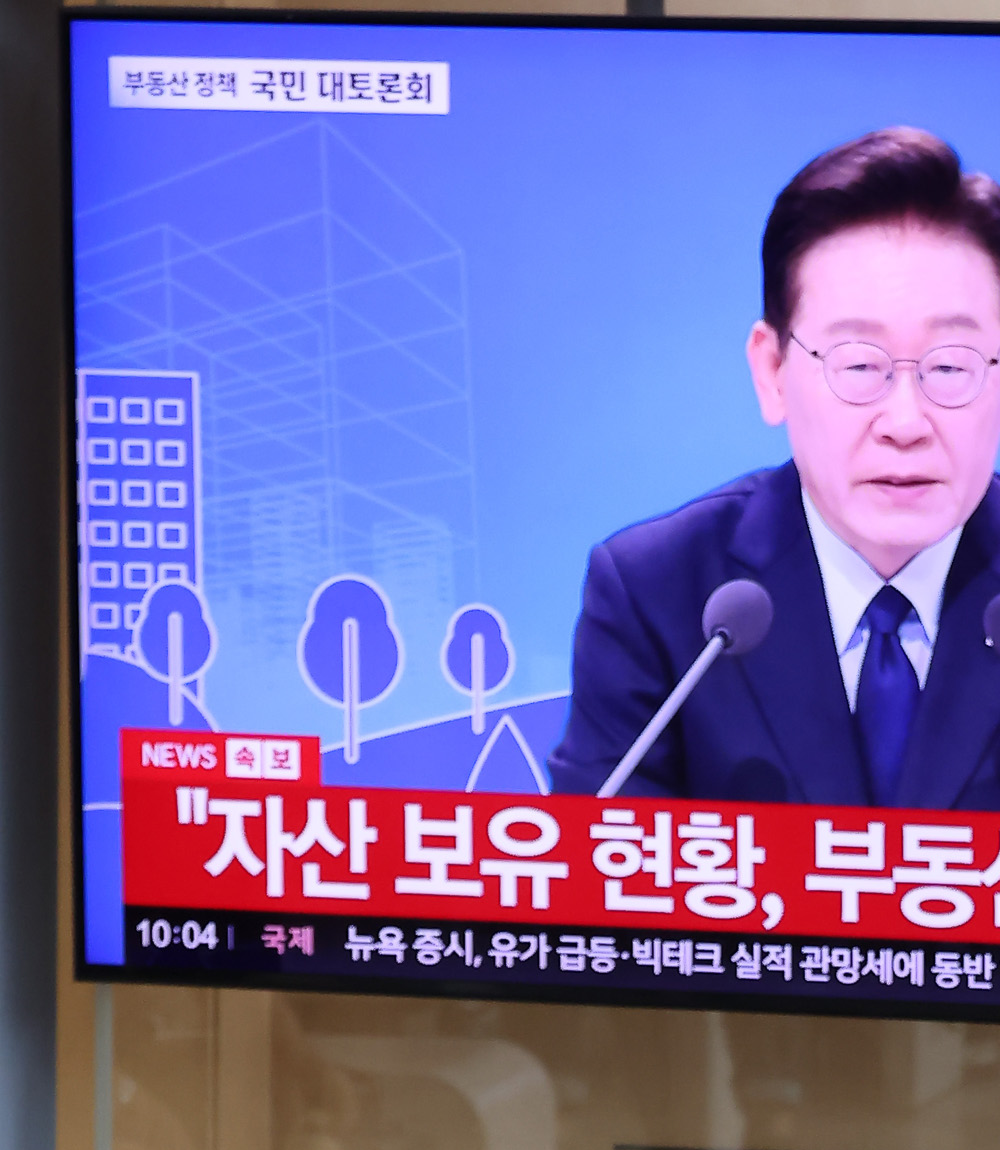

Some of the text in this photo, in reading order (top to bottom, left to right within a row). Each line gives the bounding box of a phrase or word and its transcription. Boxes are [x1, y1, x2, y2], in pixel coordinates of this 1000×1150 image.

[123, 70, 431, 104] 부동산 정책 국민 대토론회
[141, 742, 292, 771] NEWS 속보
[176, 786, 379, 900] "자산
[394, 802, 570, 910] 보유
[589, 809, 785, 931] 현황,
[136, 918, 219, 950] 10:04
[261, 924, 315, 957] 국제
[345, 924, 407, 964] 뉴욕
[412, 928, 483, 968] 증시,
[487, 932, 553, 970] 유가
[731, 941, 793, 982] 실적
[799, 945, 925, 987] 관망세에
[931, 950, 995, 990] 동반
